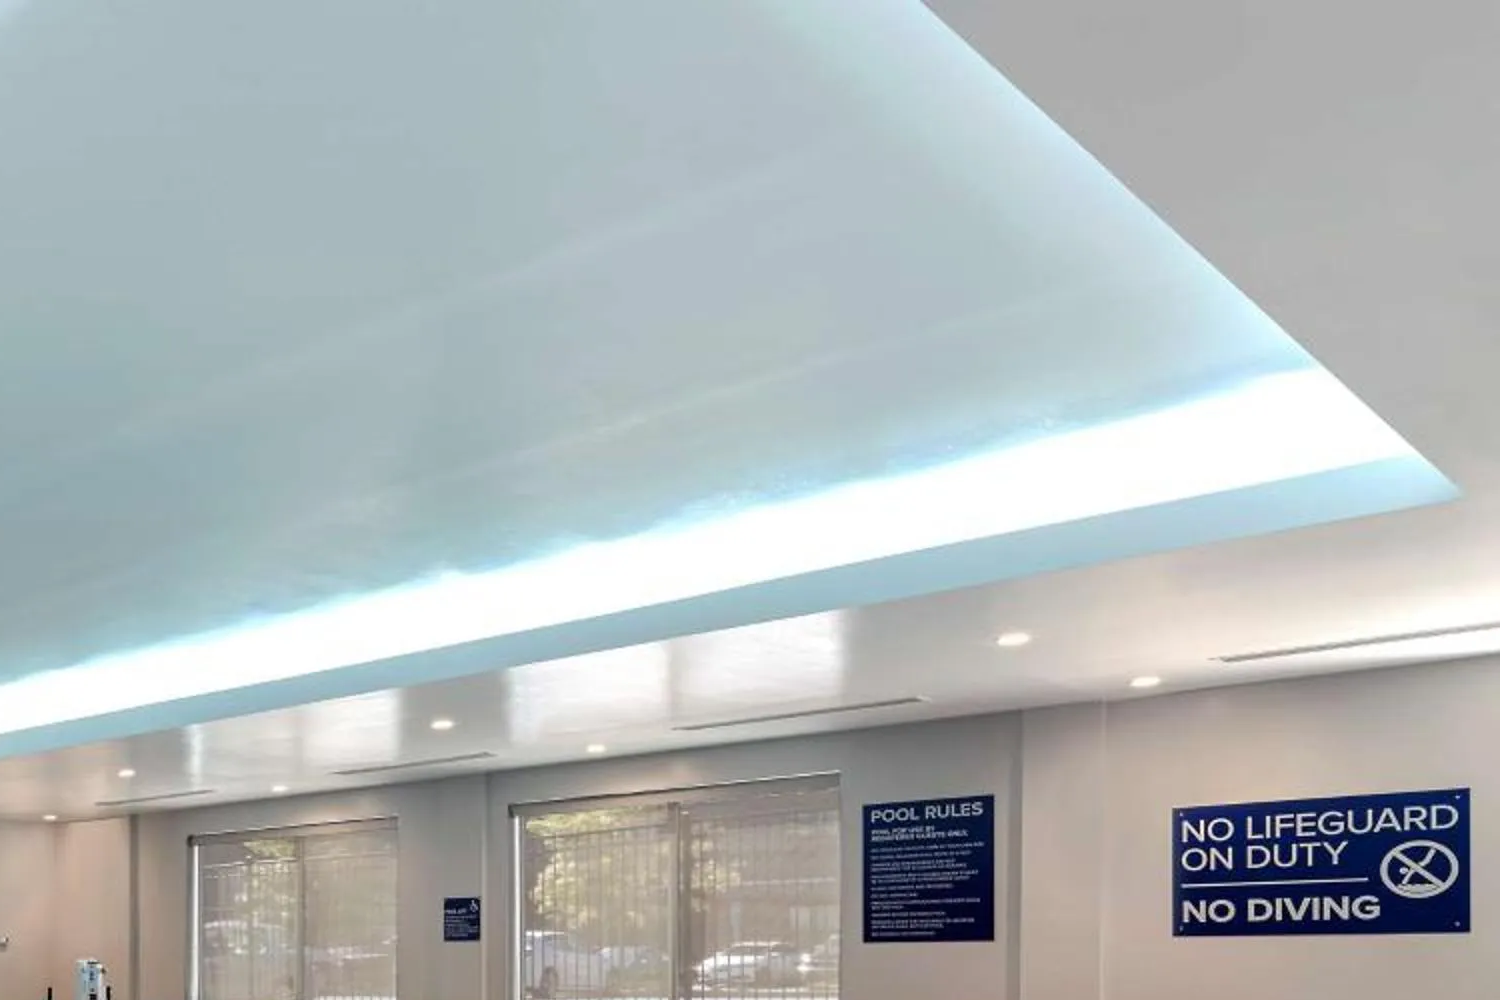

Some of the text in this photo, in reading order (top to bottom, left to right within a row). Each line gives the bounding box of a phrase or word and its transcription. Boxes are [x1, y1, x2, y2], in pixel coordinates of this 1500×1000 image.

[870, 801, 984, 824] POOL RULES
[1181, 804, 1459, 843] NO LIFEGUARD
[1181, 841, 1349, 871] ON DUTY
[1182, 895, 1381, 923] NO DIVING
